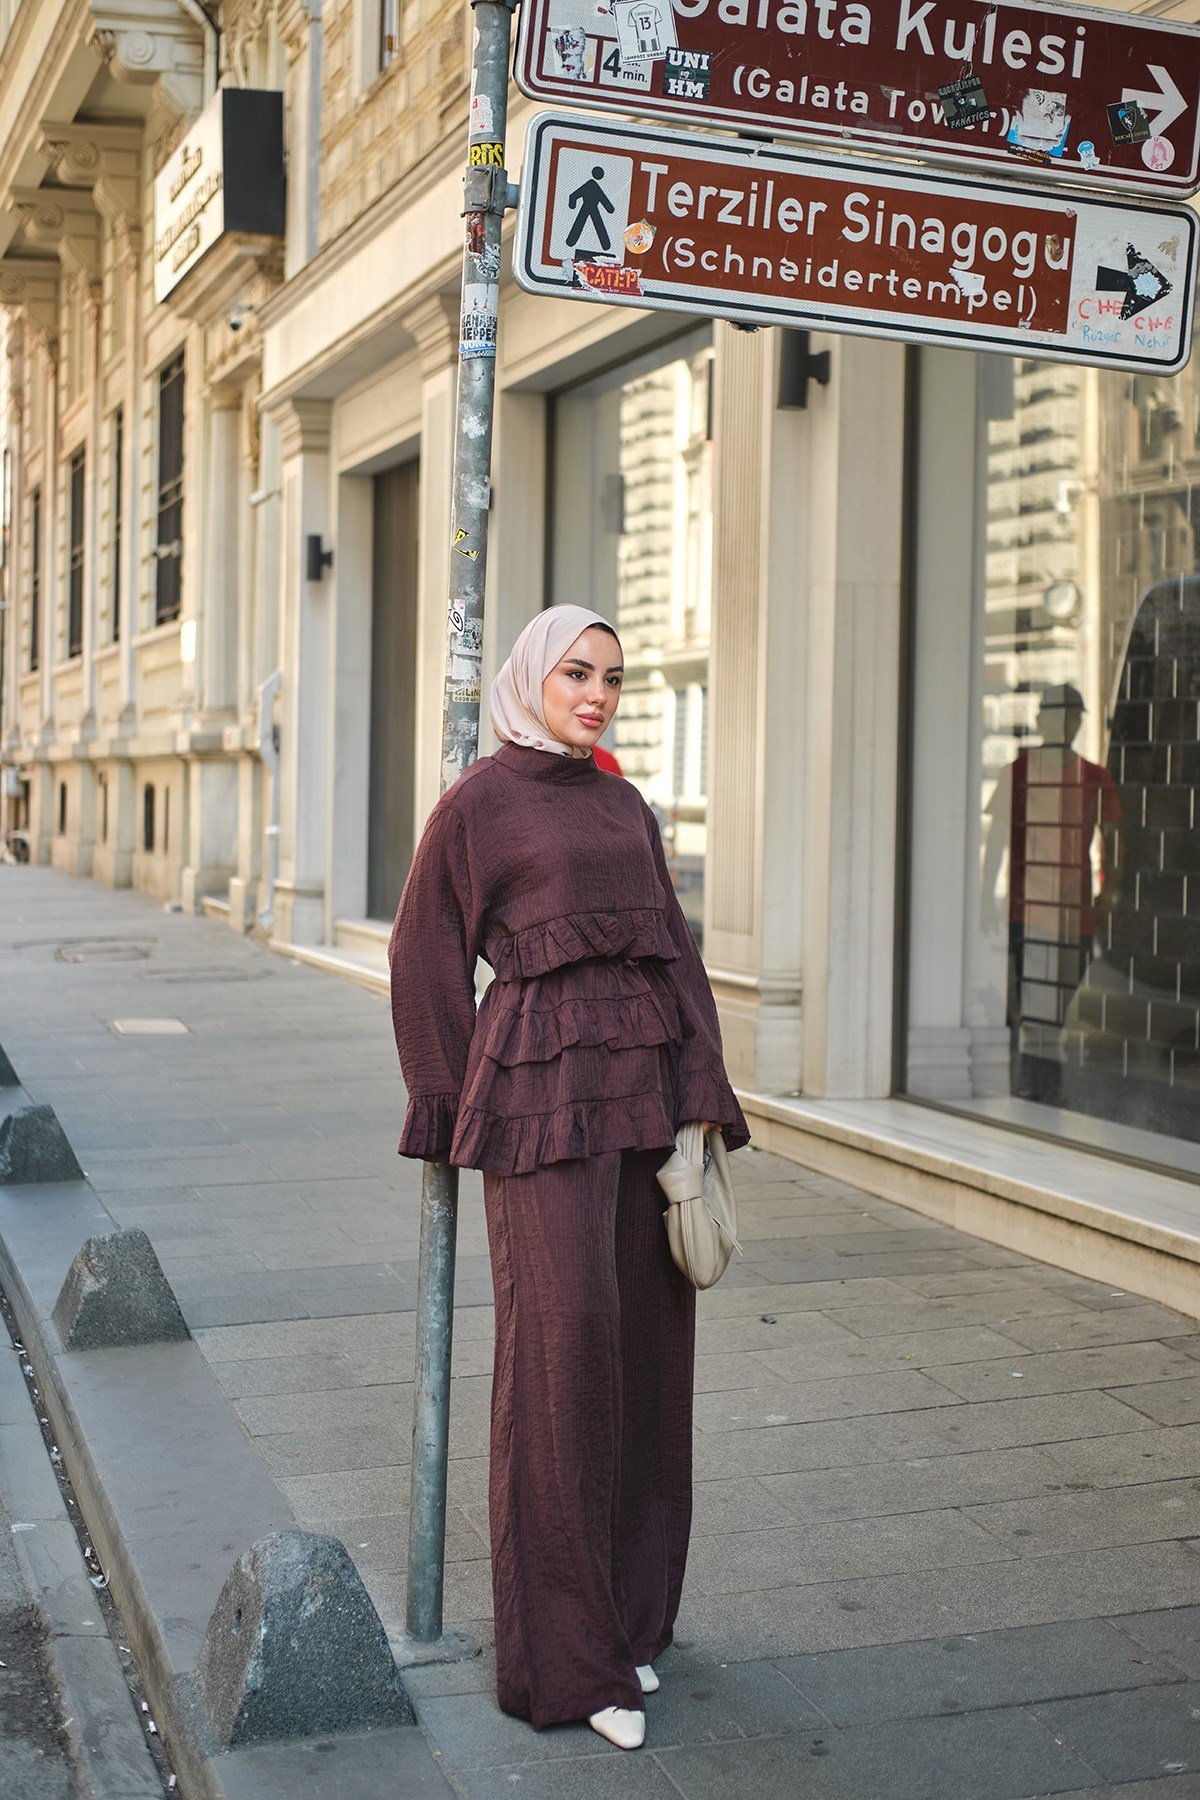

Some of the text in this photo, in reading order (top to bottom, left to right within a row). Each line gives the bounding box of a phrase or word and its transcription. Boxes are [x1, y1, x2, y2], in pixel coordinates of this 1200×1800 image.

[639, 17, 651, 30] 13
[896, 0, 1086, 78] Kulesi
[603, 48, 622, 78] 4
[668, 49, 710, 70] UNI
[623, 71, 648, 83] min.
[668, 78, 705, 99] HM
[733, 66, 1010, 137] (Galata Towr)
[950, 110, 990, 129] FANATICS
[641, 161, 1071, 279] Terziler Sinagogu
[662, 236, 1037, 322] (Schneidertempel)
[1078, 298, 1123, 319] CHE
